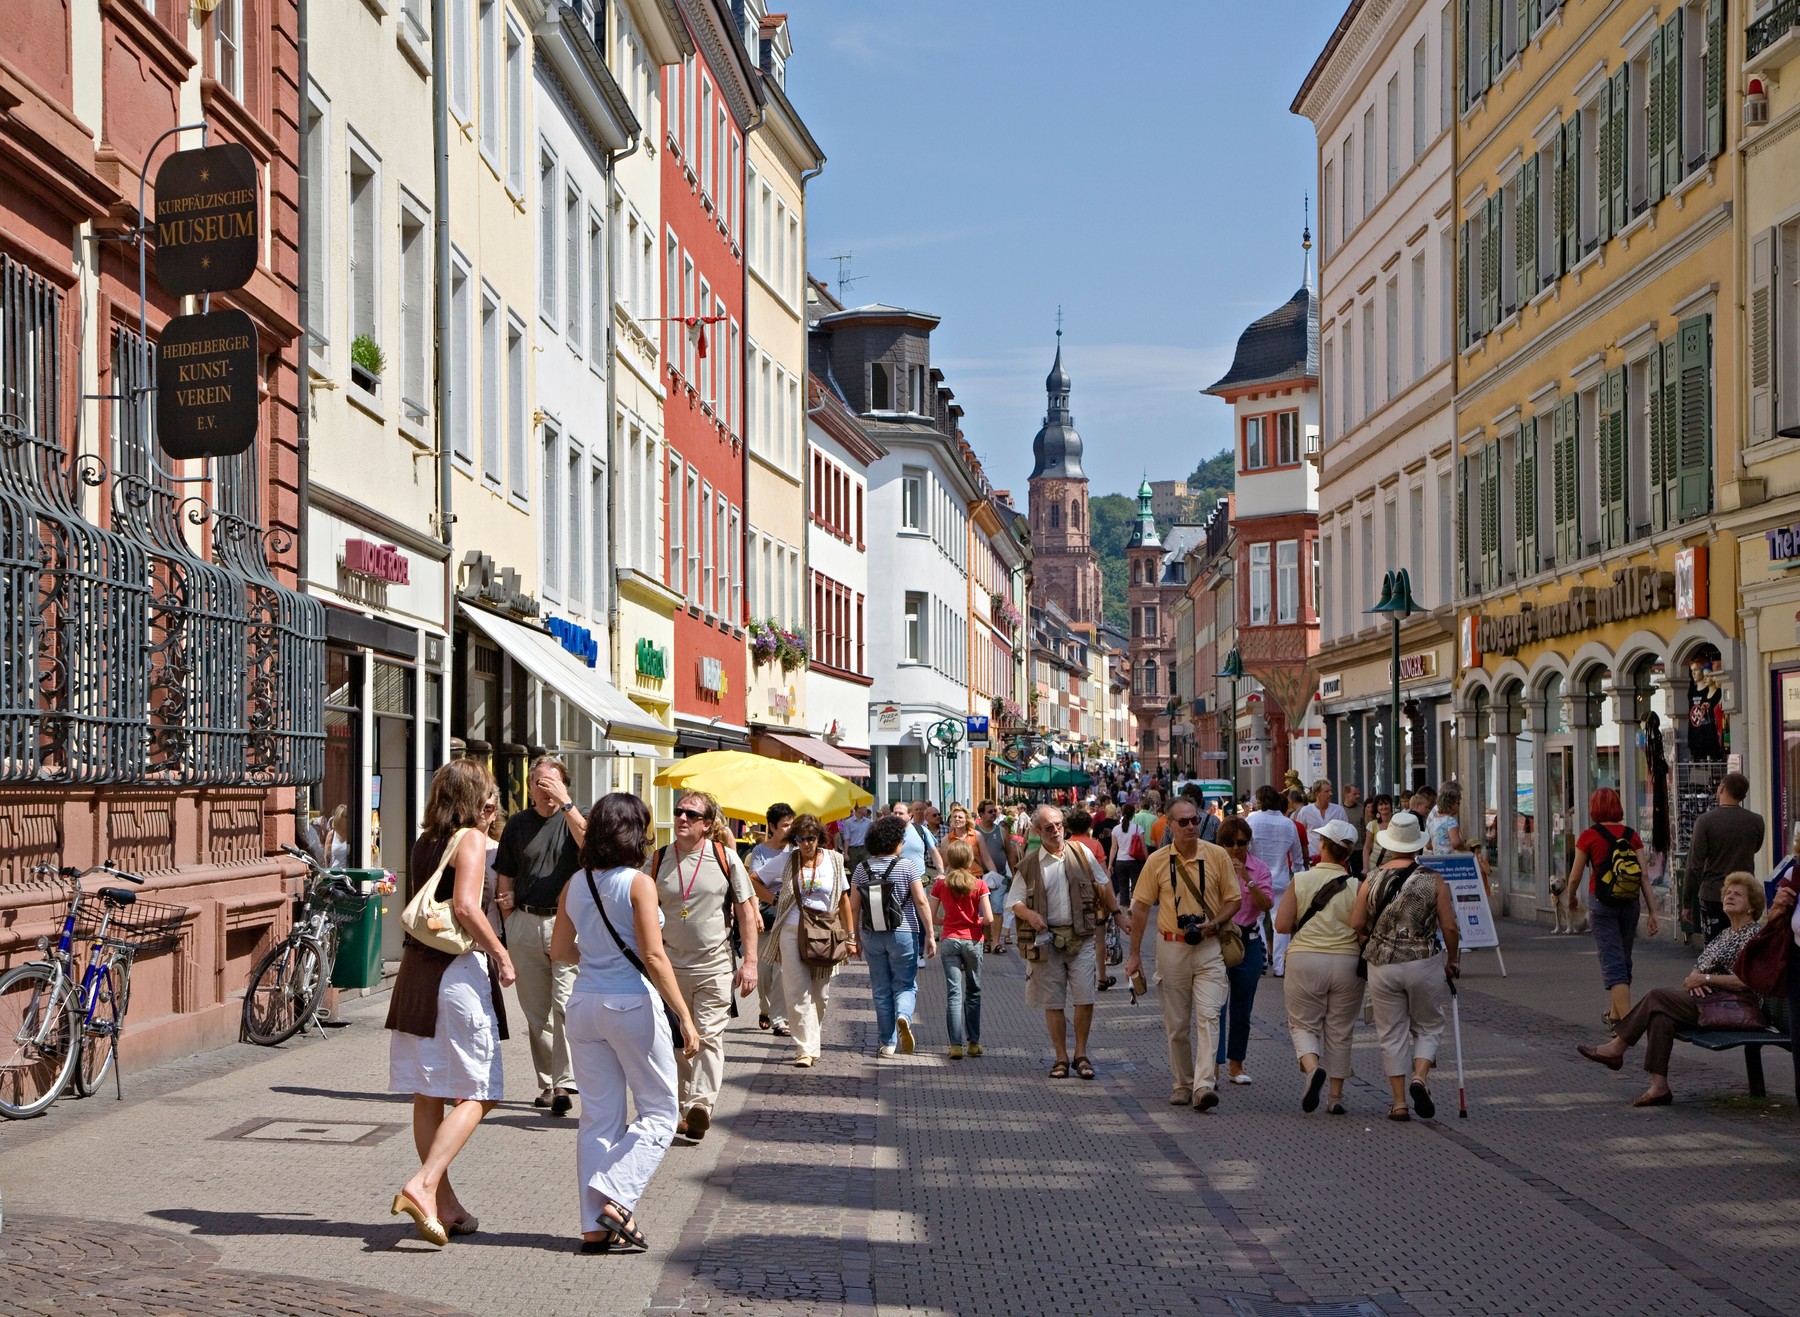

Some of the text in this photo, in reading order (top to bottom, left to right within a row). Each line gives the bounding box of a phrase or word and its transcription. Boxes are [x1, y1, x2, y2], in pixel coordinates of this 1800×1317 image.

[158, 188, 255, 215] KURPFÄLZISCHES
[158, 210, 255, 248] MUSEUM
[162, 335, 250, 359] HEIDELBERGER
[178, 359, 234, 382] KUNST-
[176, 385, 232, 407] VEREIN
[196, 415, 217, 430] E.V.
[1475, 568, 1661, 653] drogerie markt müller
[879, 712, 898, 722] Pizza
[1240, 744, 1259, 753] eye
[1241, 757, 1260, 766] art
